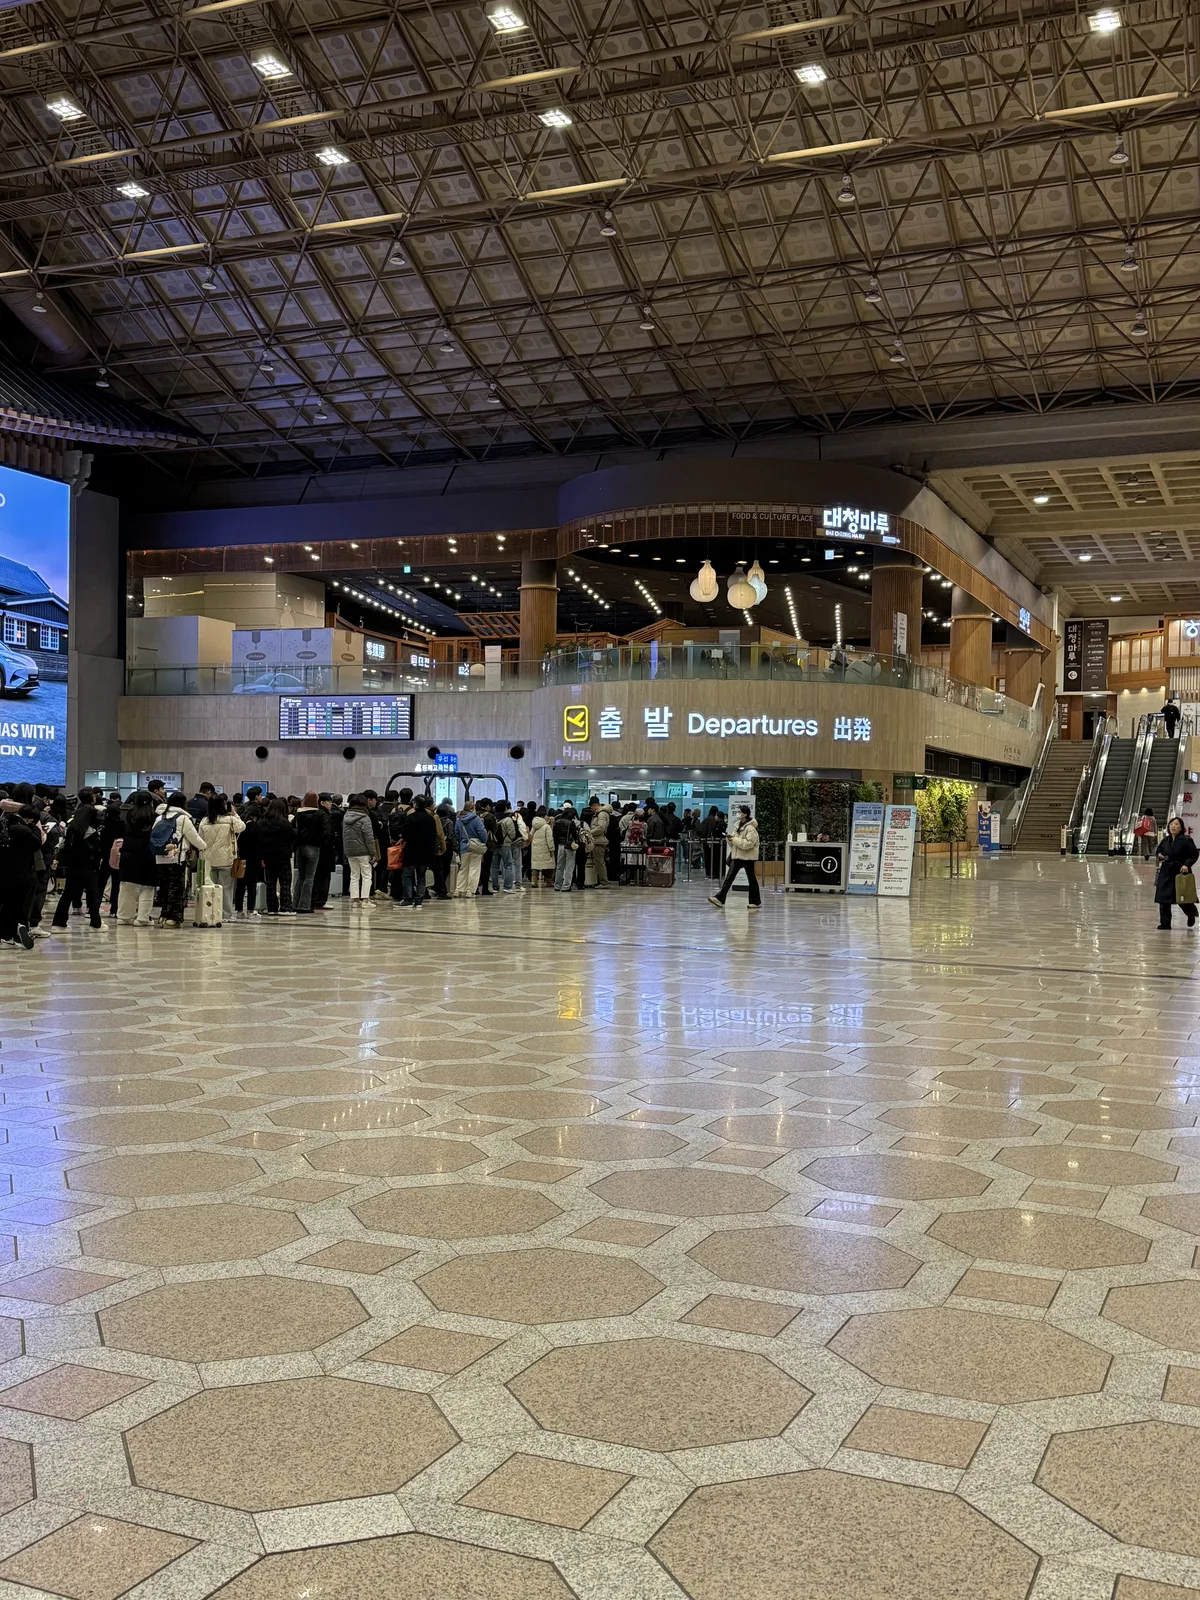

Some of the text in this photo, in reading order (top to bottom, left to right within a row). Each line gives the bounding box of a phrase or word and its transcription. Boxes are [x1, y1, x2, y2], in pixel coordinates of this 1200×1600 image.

[759, 513, 791, 521] CULTURE
[792, 514, 814, 522] PLACE
[823, 507, 889, 534] 대청마루
[359, 616, 364, 628] 5
[403, 631, 408, 640] 4
[1067, 624, 1078, 661] 대청마루
[21, 724, 54, 739] WITH
[688, 713, 818, 738] Departures
[833, 717, 871, 741] 出発
[26, 746, 37, 756] 7
